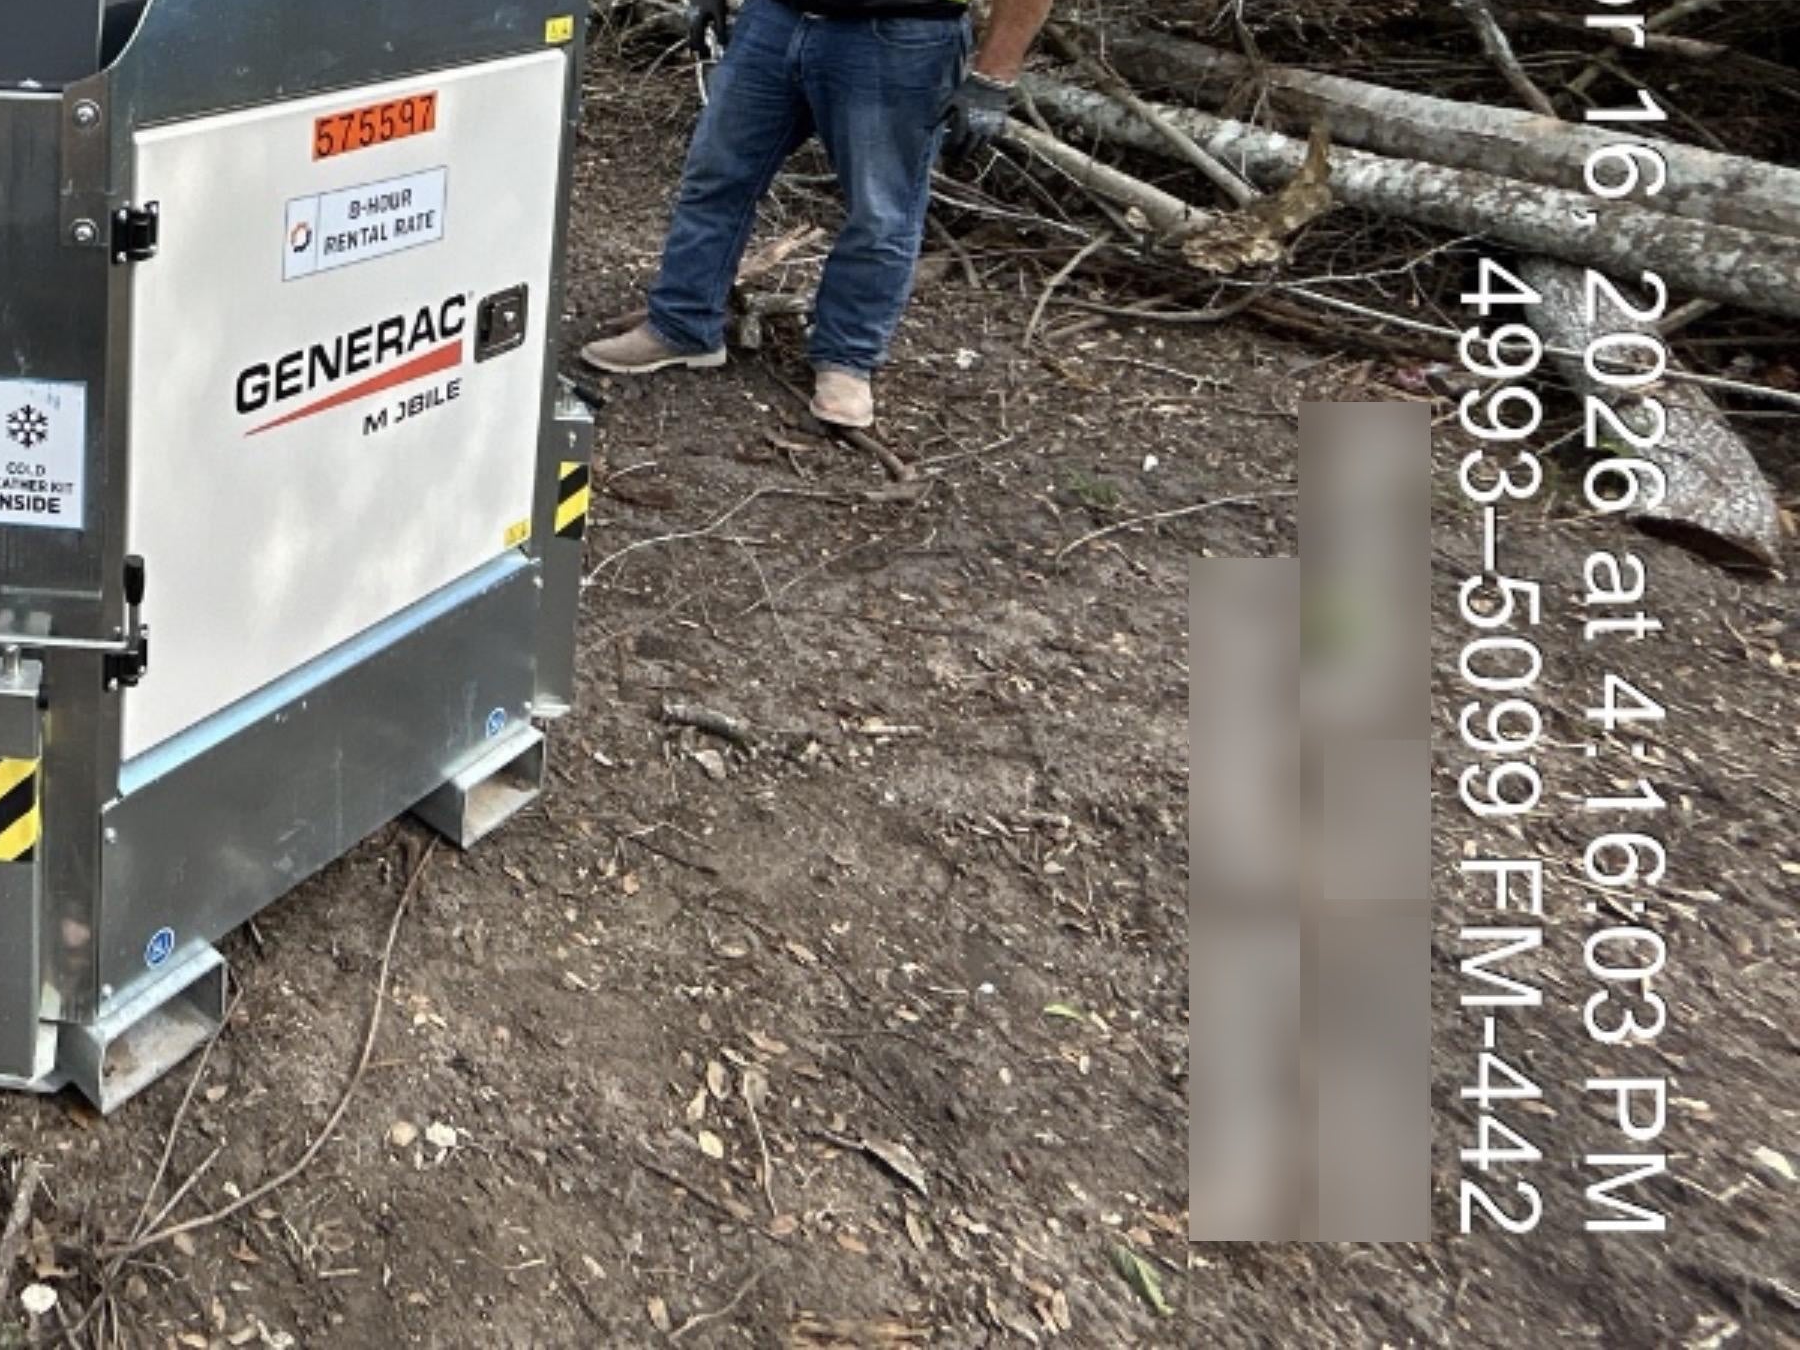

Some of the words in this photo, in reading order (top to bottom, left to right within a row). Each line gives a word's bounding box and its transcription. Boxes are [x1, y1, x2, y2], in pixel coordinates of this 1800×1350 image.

[316, 94, 434, 156] 575597
[324, 223, 388, 256] RENTAL
[394, 209, 436, 237] RATE
[236, 292, 466, 415] GENERAC
[5, 461, 46, 477] COLD
[50, 481, 74, 494] KIT
